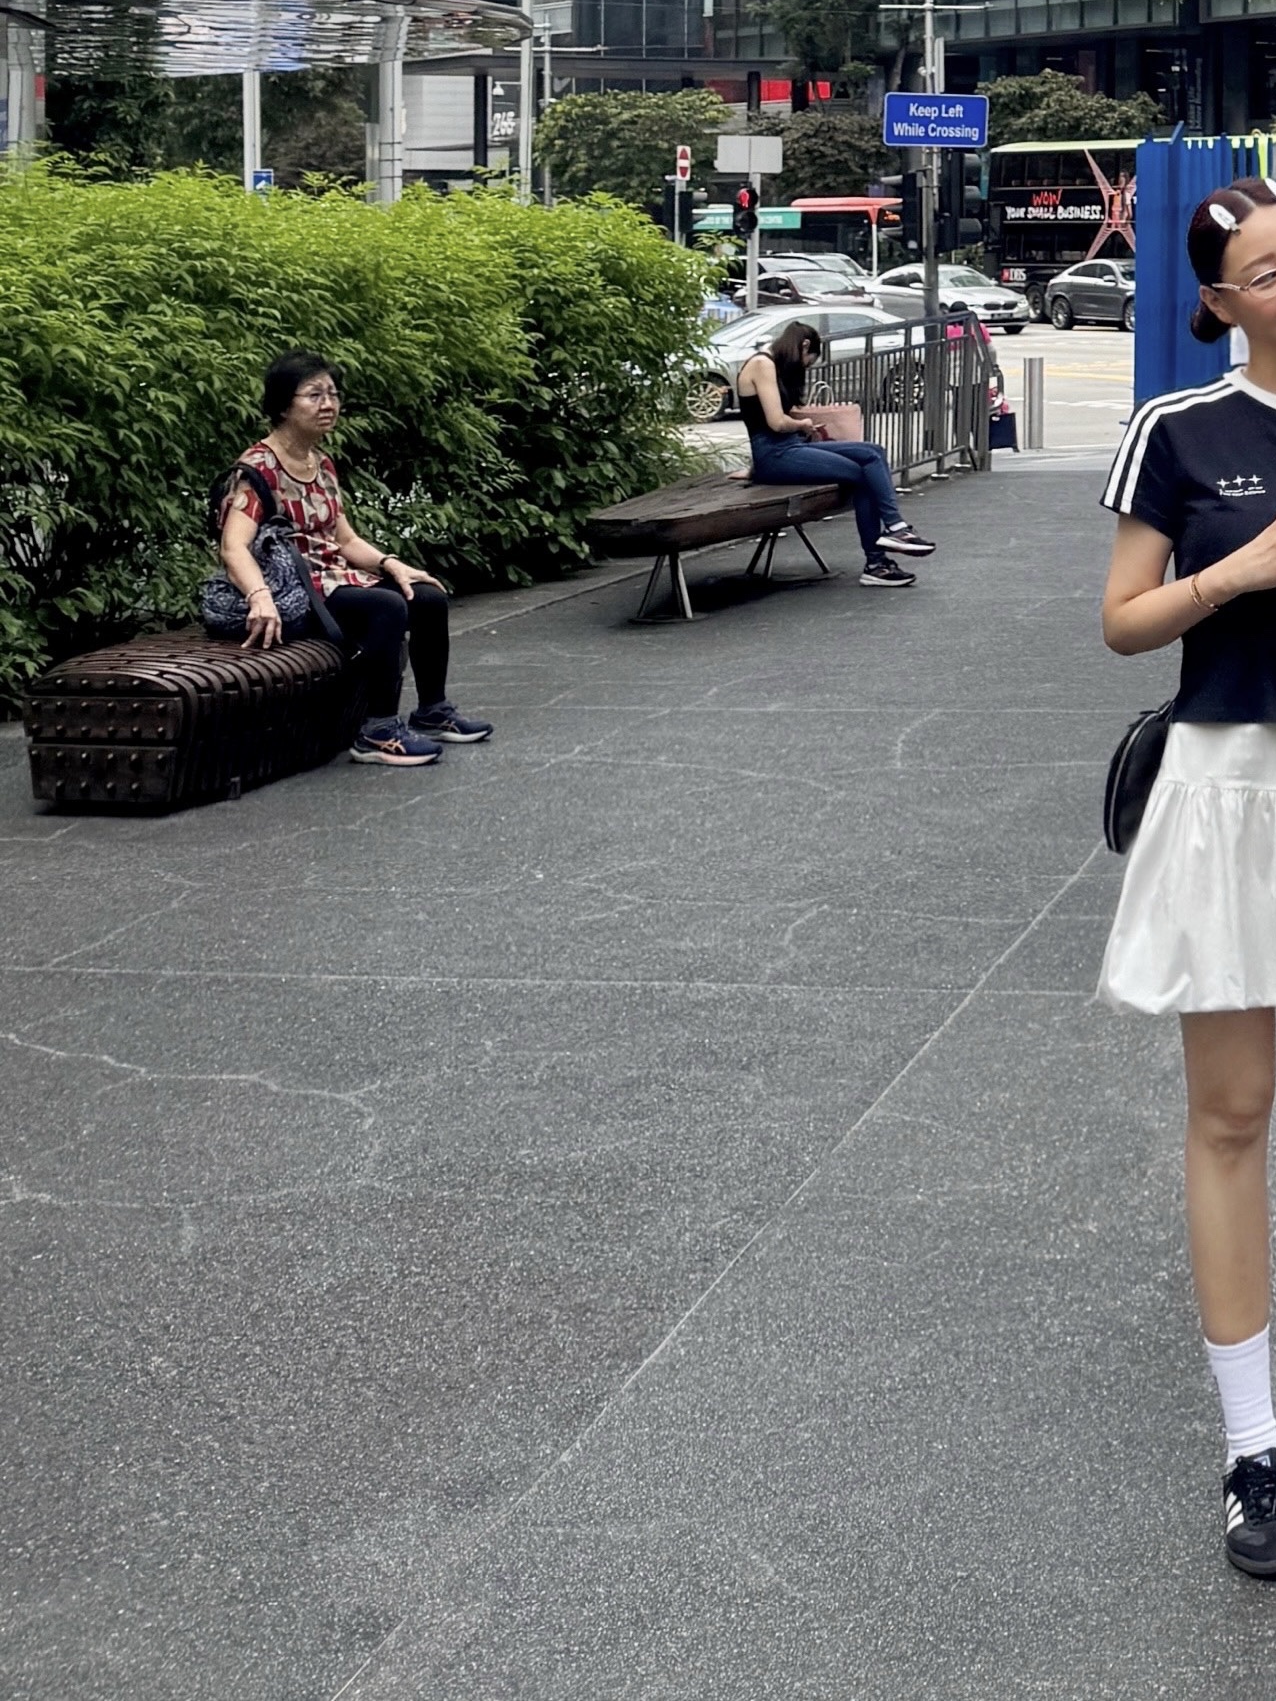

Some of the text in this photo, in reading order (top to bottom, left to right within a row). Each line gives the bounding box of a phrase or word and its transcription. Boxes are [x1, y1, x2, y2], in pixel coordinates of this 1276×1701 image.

[908, 102, 964, 120] Keep Left
[893, 122, 980, 142] While Crossing
[1032, 188, 1063, 206] WOW
[1026, 206, 1056, 220] SMALL
[1009, 268, 1027, 281] DBS
